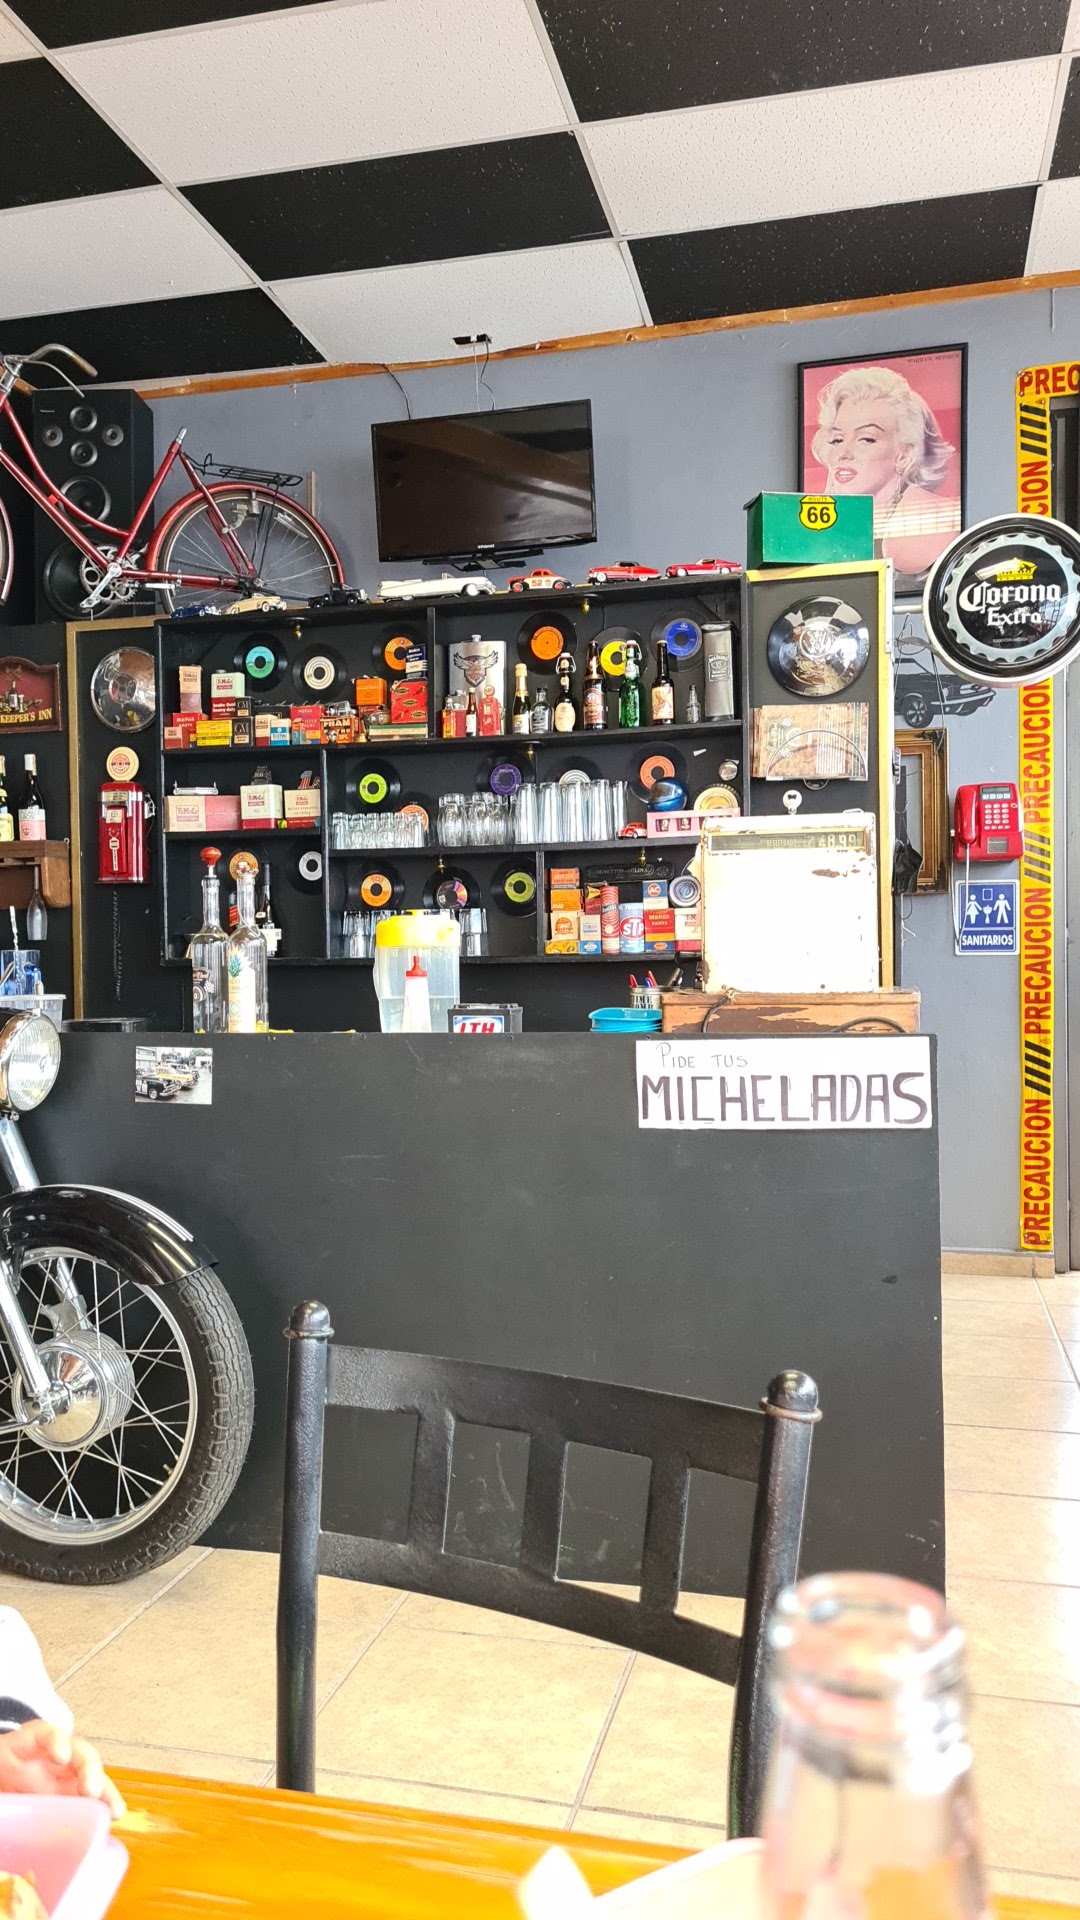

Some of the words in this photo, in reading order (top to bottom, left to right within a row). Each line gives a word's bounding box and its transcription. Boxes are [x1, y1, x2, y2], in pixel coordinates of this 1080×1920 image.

[807, 506, 830, 523] 66
[959, 581, 1061, 613] Corona
[987, 606, 1041, 632] Extra
[38, 708, 53, 721] INN
[623, 919, 645, 937] STP
[962, 934, 1014, 946] SANITARIOS
[1023, 888, 1051, 1034] PRECAUCION
[711, 1054, 748, 1068] TUS
[642, 1072, 928, 1124] MICHELADAS
[1023, 1099, 1051, 1245] PRECAUCION
